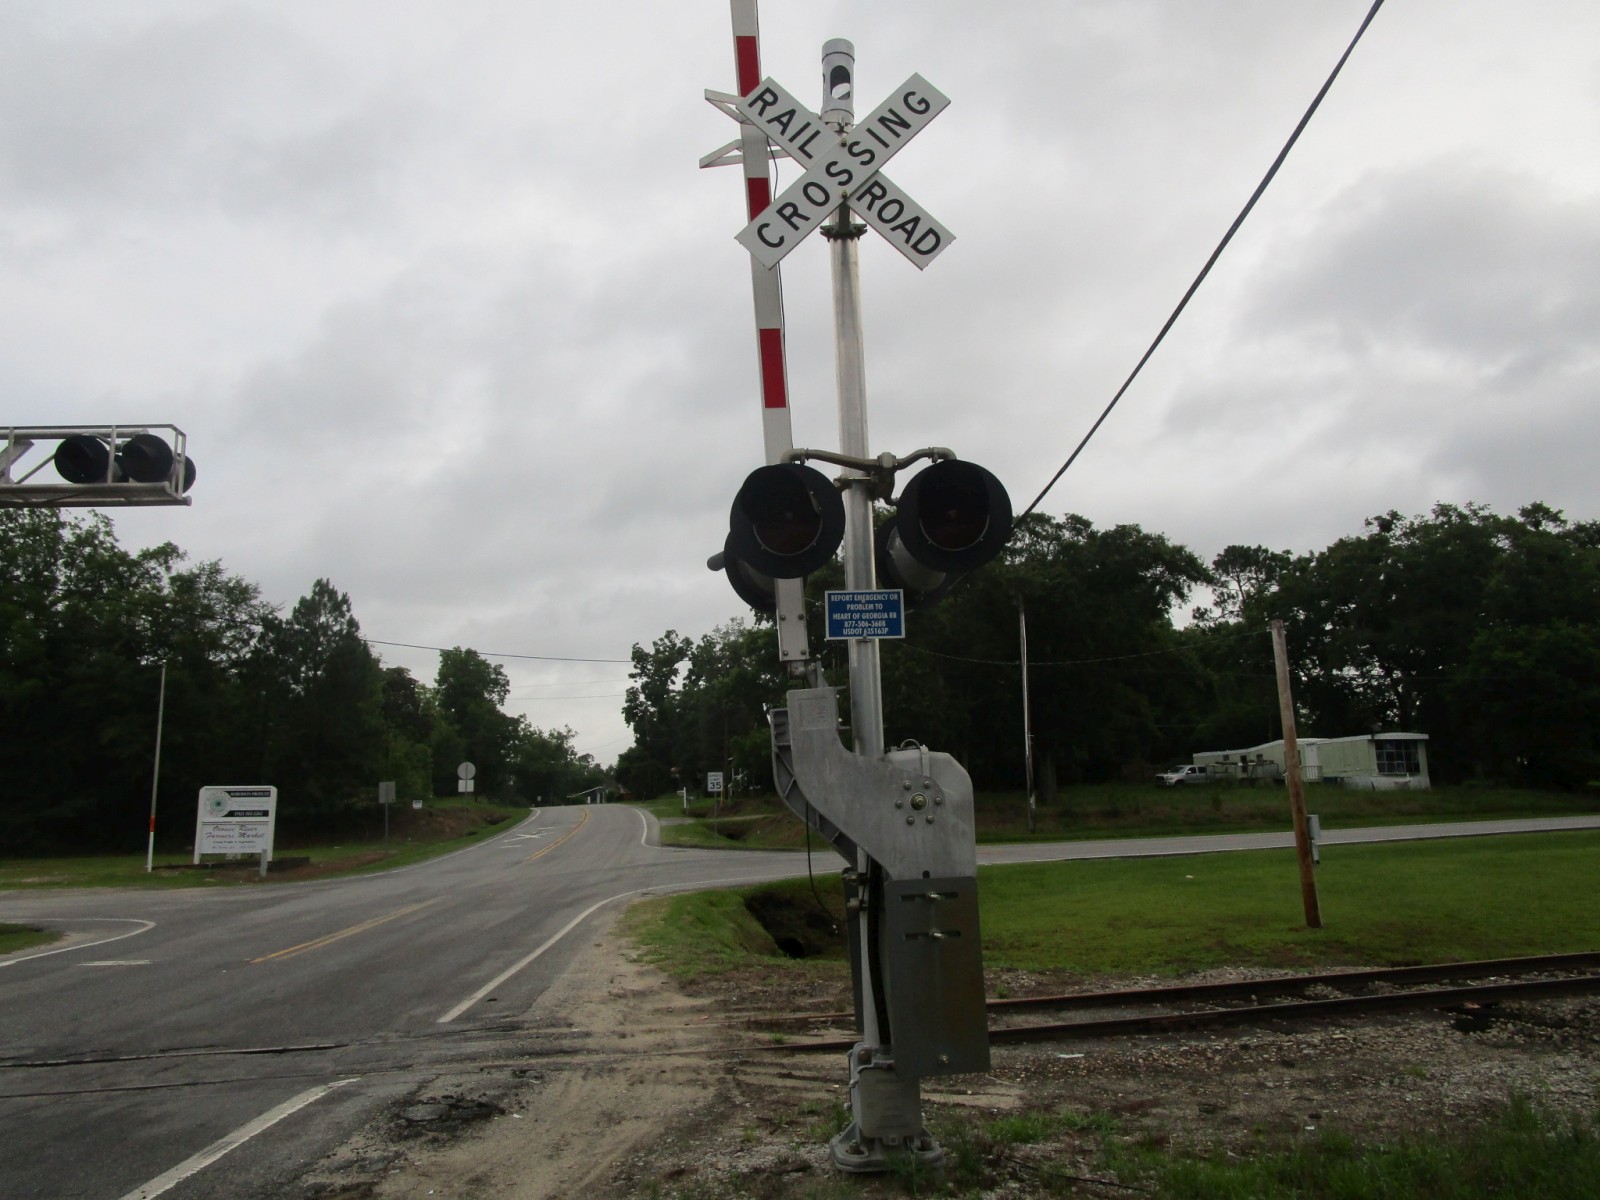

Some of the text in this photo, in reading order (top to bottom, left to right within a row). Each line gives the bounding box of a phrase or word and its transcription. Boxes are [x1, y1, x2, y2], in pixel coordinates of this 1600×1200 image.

[748, 87, 821, 159] RAIL
[757, 91, 931, 248] CROSSING
[856, 180, 941, 255] ROAD
[710, 781, 721, 789] 35
